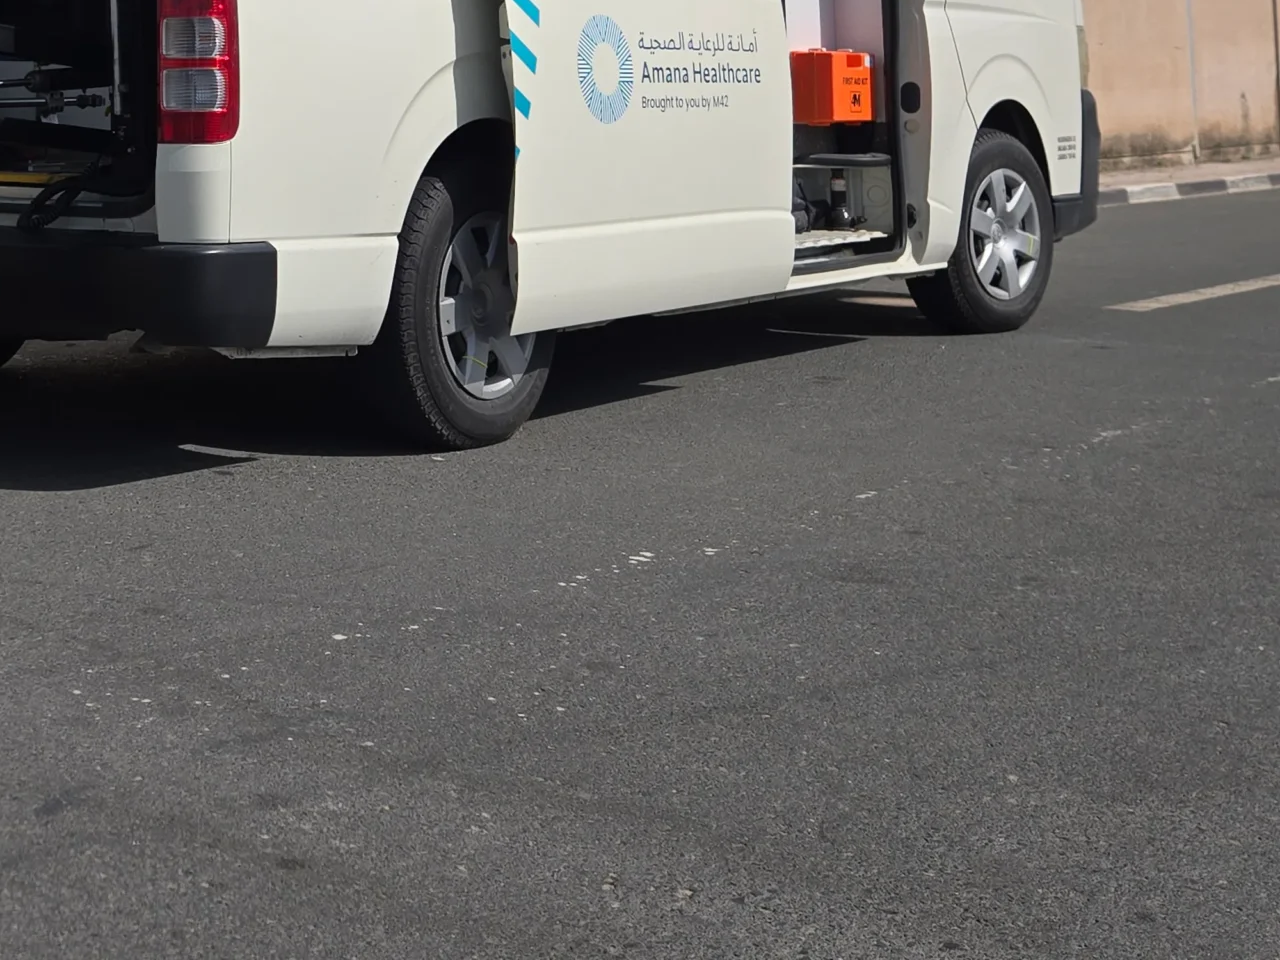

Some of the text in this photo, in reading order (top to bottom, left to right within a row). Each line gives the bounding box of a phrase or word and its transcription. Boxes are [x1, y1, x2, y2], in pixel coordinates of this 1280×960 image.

[638, 28, 758, 57] أمانة للرعاية الصحية
[641, 61, 761, 84] Amana Healthcare
[842, 76, 853, 85] FIRST
[641, 95, 729, 112] Brought to you by M42
